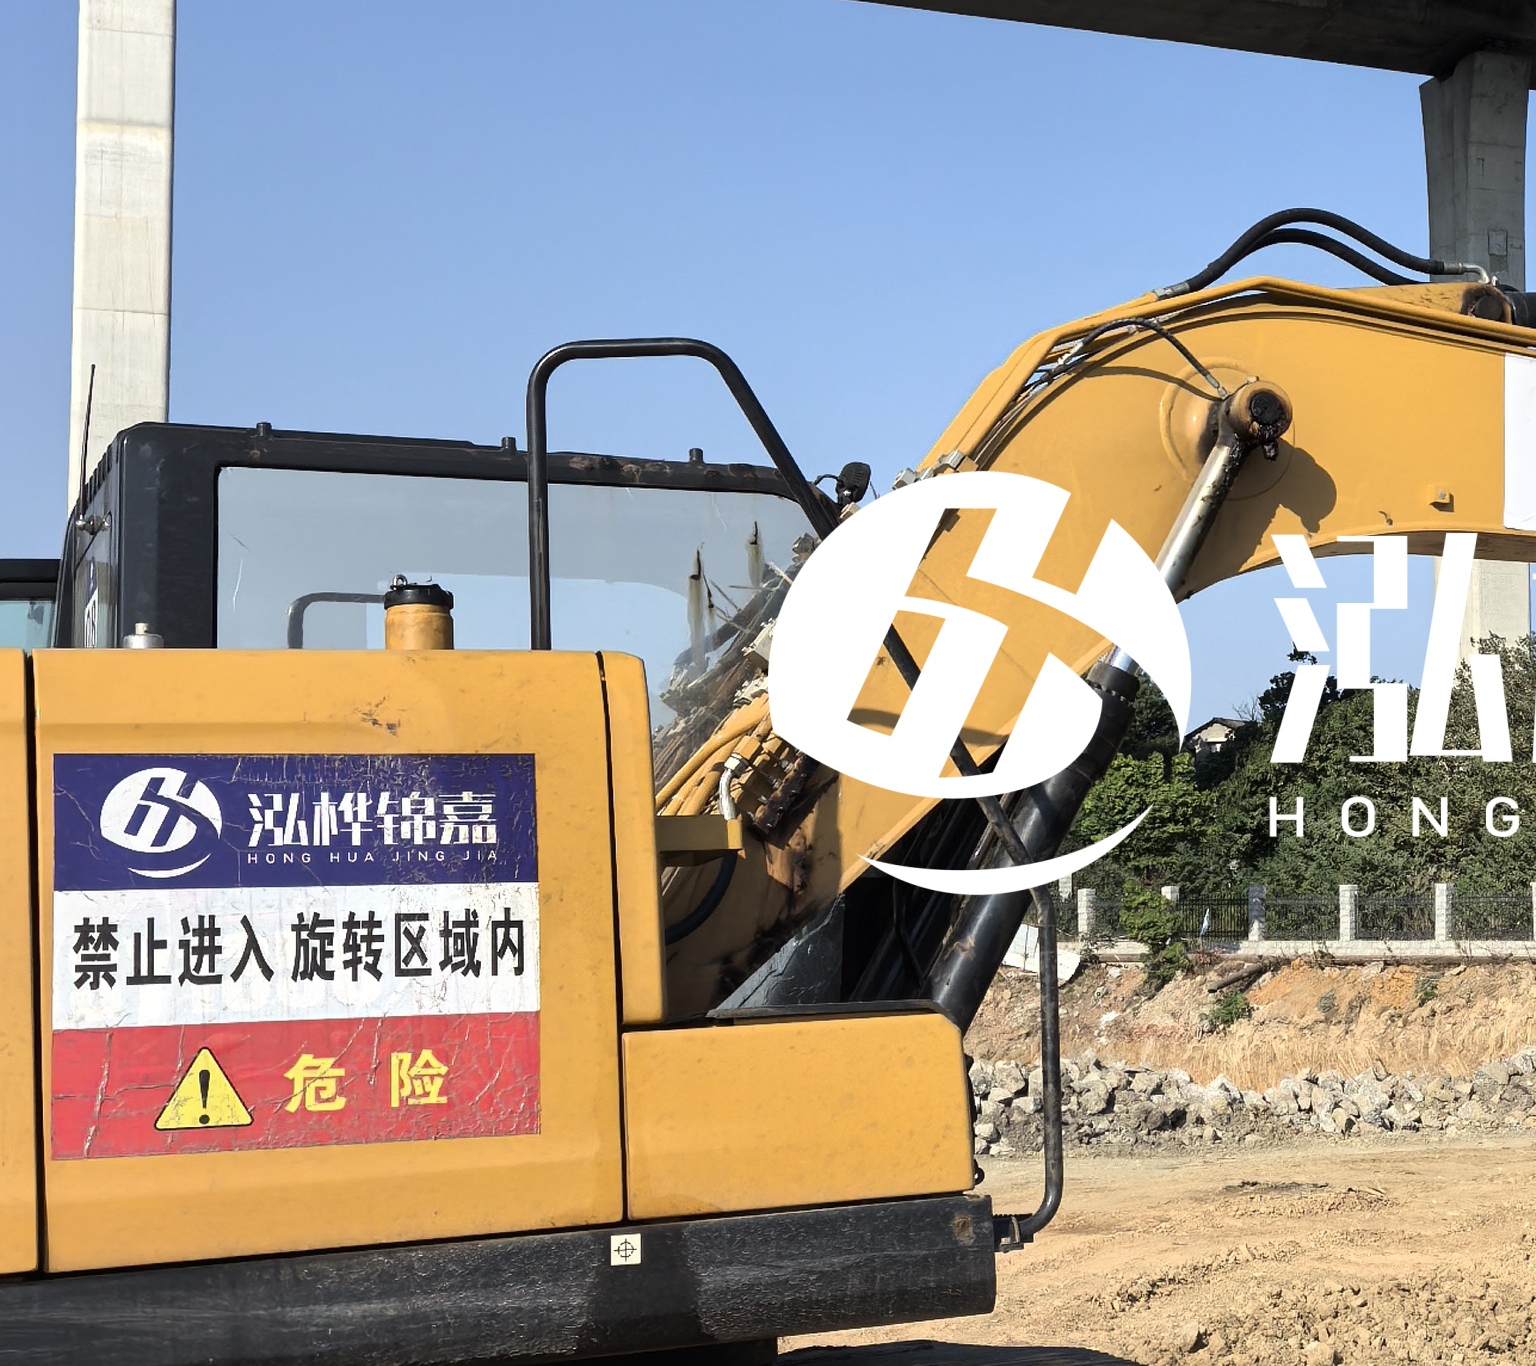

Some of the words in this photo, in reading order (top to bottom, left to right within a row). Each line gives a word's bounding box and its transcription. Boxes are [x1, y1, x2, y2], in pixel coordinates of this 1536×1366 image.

[247, 790, 498, 848] 泓桦锦嘉
[247, 852, 312, 864] HONG
[329, 851, 375, 864] HUA
[391, 850, 446, 863] JING
[462, 849, 499, 862] JIA
[282, 1048, 449, 1114] 危险
